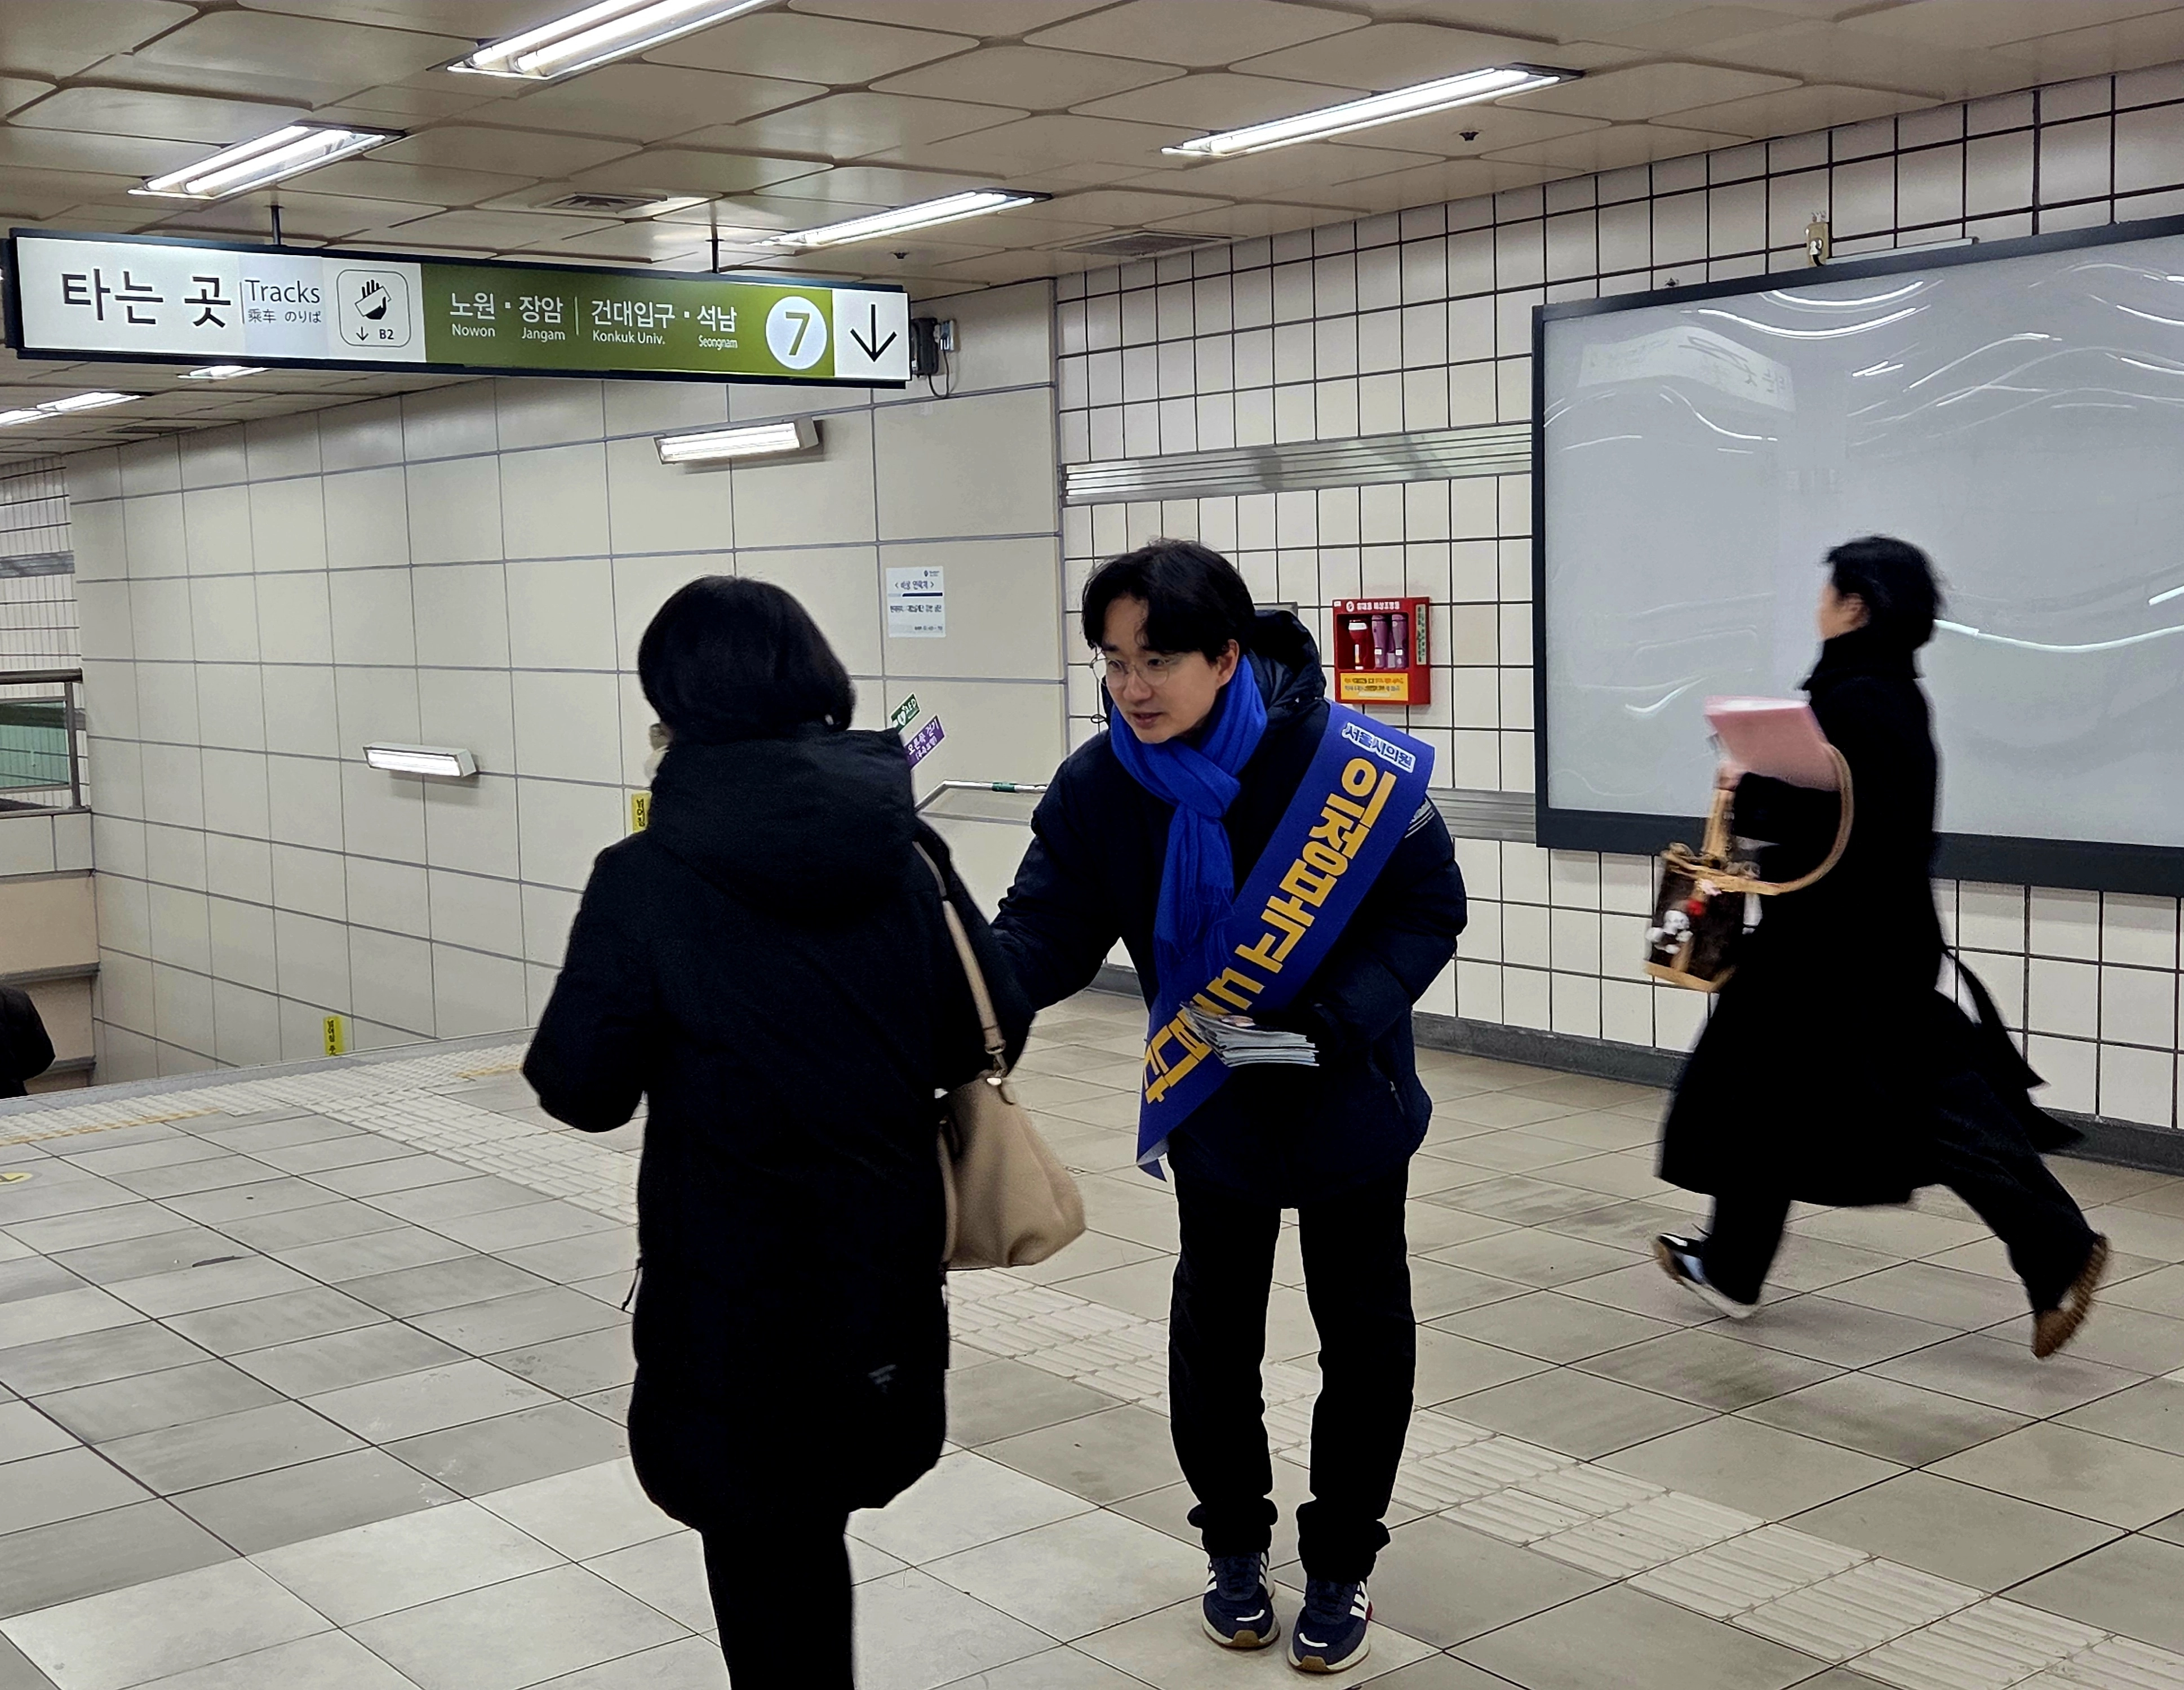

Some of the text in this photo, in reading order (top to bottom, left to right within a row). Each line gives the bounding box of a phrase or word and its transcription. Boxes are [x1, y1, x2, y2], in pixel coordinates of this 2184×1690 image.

[61, 268, 231, 328] 타는 곳
[245, 279, 320, 303] Tracks
[285, 310, 322, 323] のりば
[450, 292, 737, 332] 노원 장암 건대입구 석남
[379, 329, 394, 340] B2
[452, 323, 738, 350] Nowon Jangam Konkuk Univ. Seongnam
[785, 312, 810, 356] 7
[1345, 726, 1411, 770] 서울시의원
[1235, 758, 1397, 973] 의정보고
